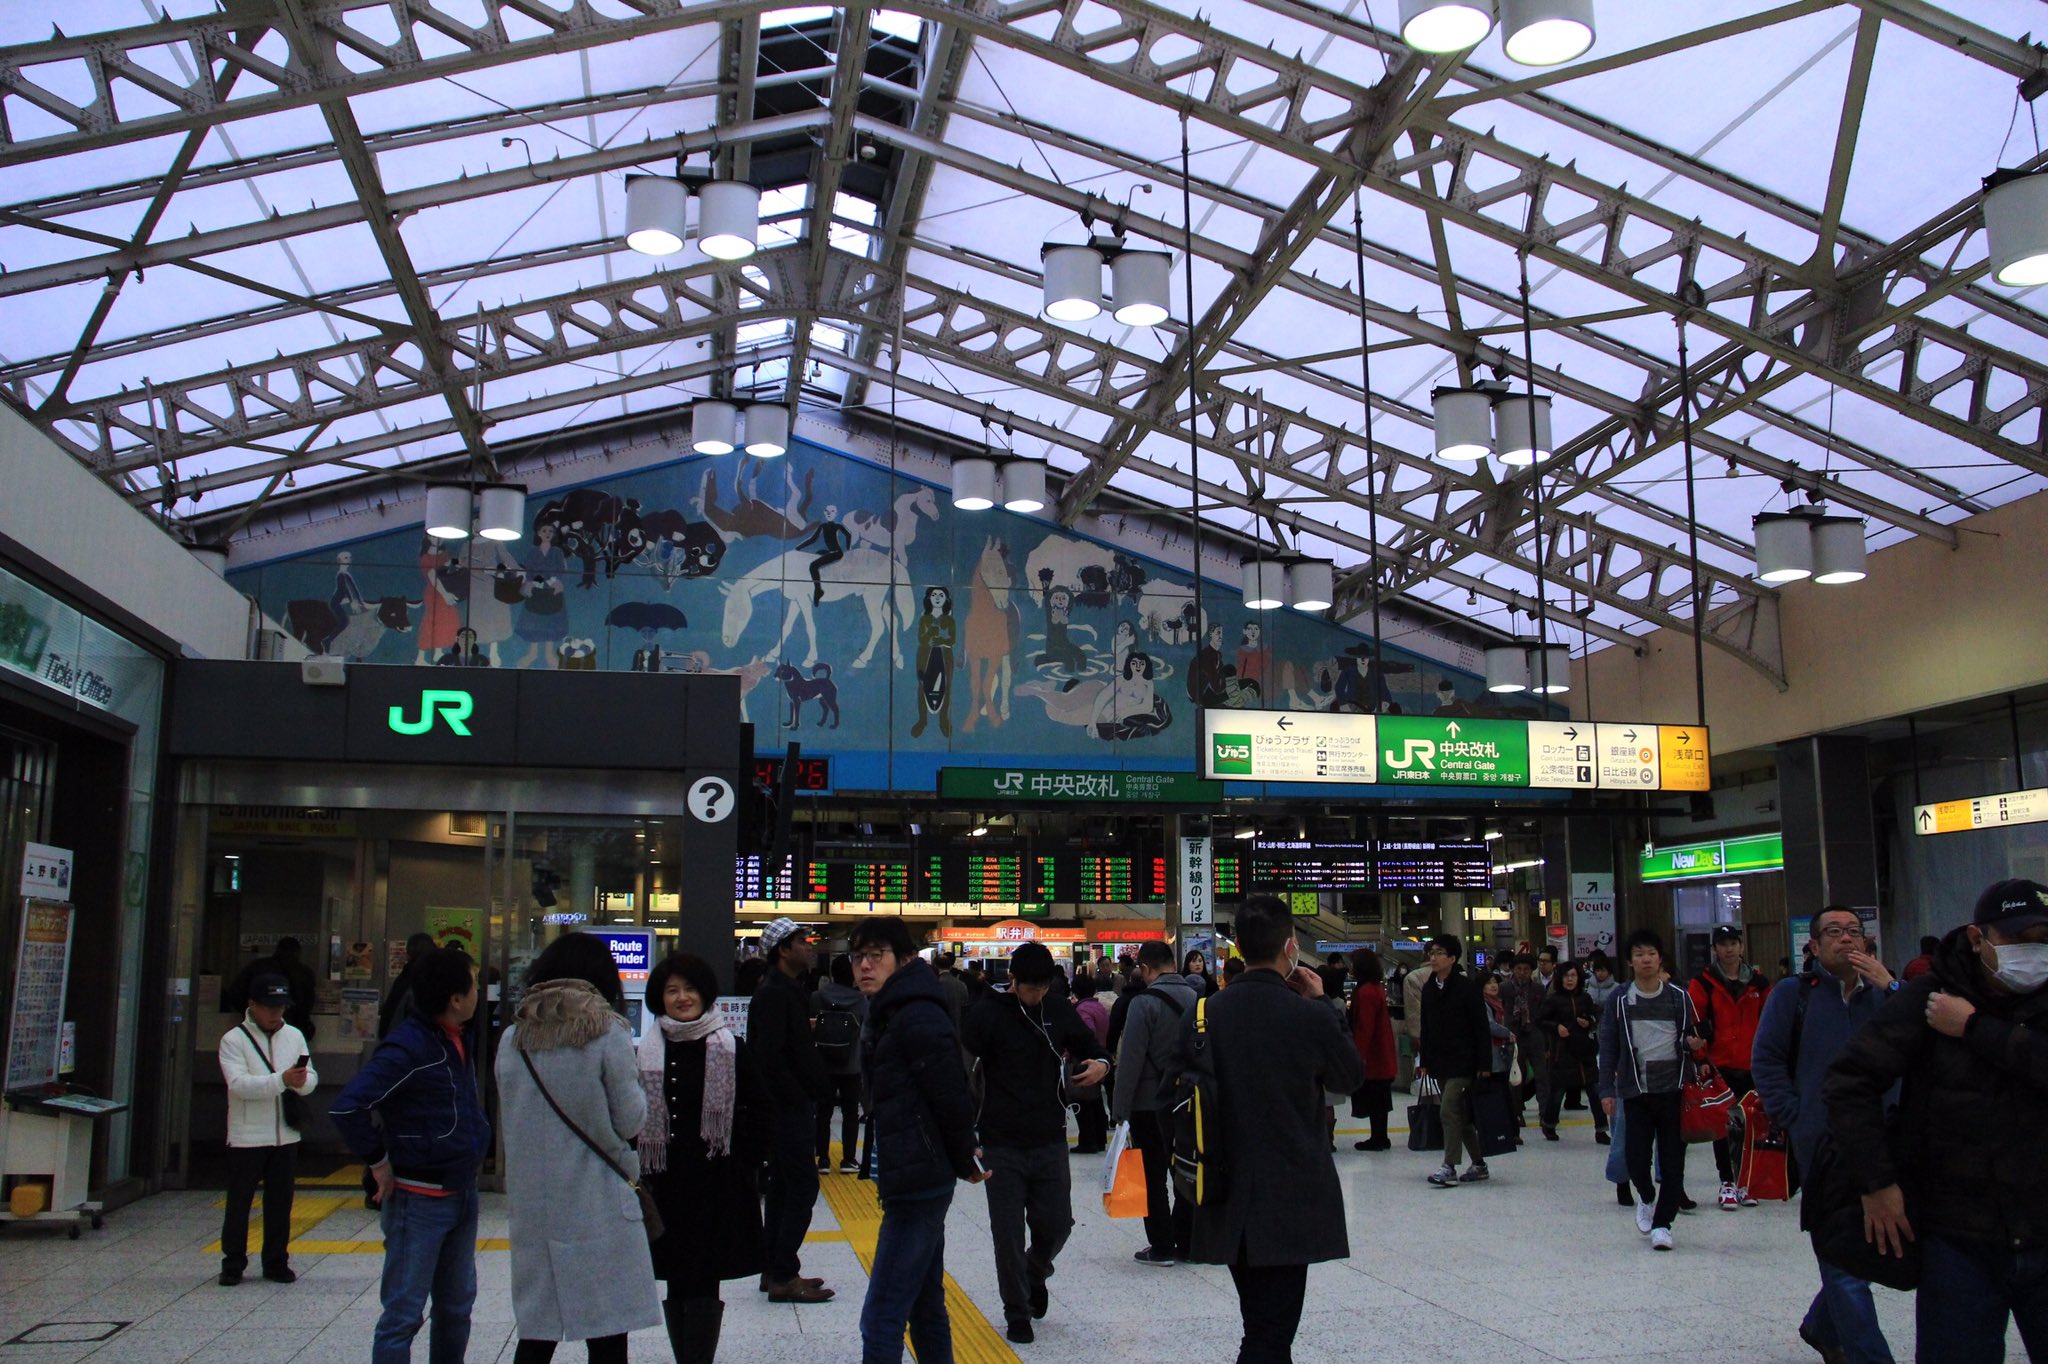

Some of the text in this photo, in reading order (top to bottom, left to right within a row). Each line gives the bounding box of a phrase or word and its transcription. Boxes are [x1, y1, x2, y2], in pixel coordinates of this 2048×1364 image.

[45, 653, 112, 704] Ticket Office
[388, 689, 473, 737] JR
[1255, 735, 1310, 747] びゅうプラザ
[1216, 744, 1250, 759] びゅう
[1386, 739, 1436, 769] JR
[1439, 741, 1500, 758] 中央改札
[1543, 745, 1574, 754] ロッカー
[1610, 746, 1637, 757] 銀座線
[1673, 749, 1705, 761] 浅草口
[1440, 759, 1496, 771] Central Gate
[1540, 765, 1574, 776] 公衆電話
[1392, 770, 1431, 780] JR東日本
[1482, 772, 1497, 782] 중앙
[1602, 767, 1638, 777] 日比谷線
[993, 772, 1024, 790] JR
[1030, 773, 1119, 797] 中央改札
[1125, 774, 1175, 784] Central Gate
[1609, 777, 1624, 785] Hibiya
[232, 821, 269, 833] JAPAN
[309, 823, 337, 833] PASS
[1671, 850, 1720, 869] NewDays
[26, 862, 58, 880] 上野駅
[1188, 841, 1203, 923] 新幹線のりば
[995, 926, 1035, 940] 駅弁屋
[1097, 931, 1163, 940] GIFT GARDEN
[610, 940, 643, 951] Route
